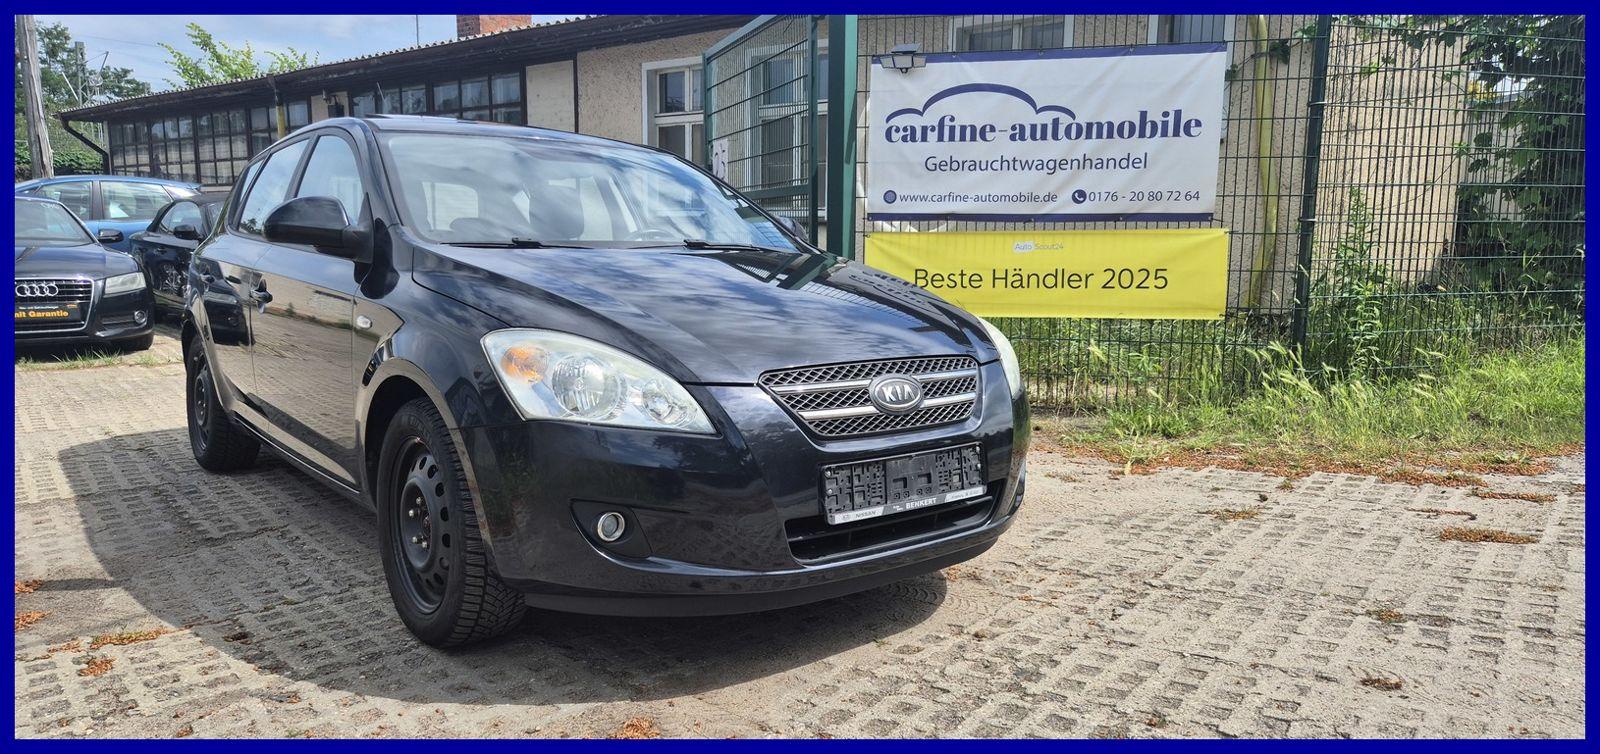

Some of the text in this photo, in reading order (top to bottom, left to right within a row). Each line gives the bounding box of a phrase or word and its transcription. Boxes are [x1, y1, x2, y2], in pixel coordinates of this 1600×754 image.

[885, 109, 1202, 143] carfine-automobile
[925, 152, 1148, 175] Gebrauchtwagenhandel
[899, 190, 1058, 203] www.carfine-automobile.de
[1088, 191, 1119, 202] 0176
[1129, 191, 1145, 202] 20
[1147, 191, 1163, 202] 80
[1166, 190, 1181, 202] 72
[1183, 190, 1200, 202] 64
[914, 267, 1169, 289] Beste Händler 2025
[882, 384, 917, 402] KIA
[905, 497, 937, 509] BENKERT
